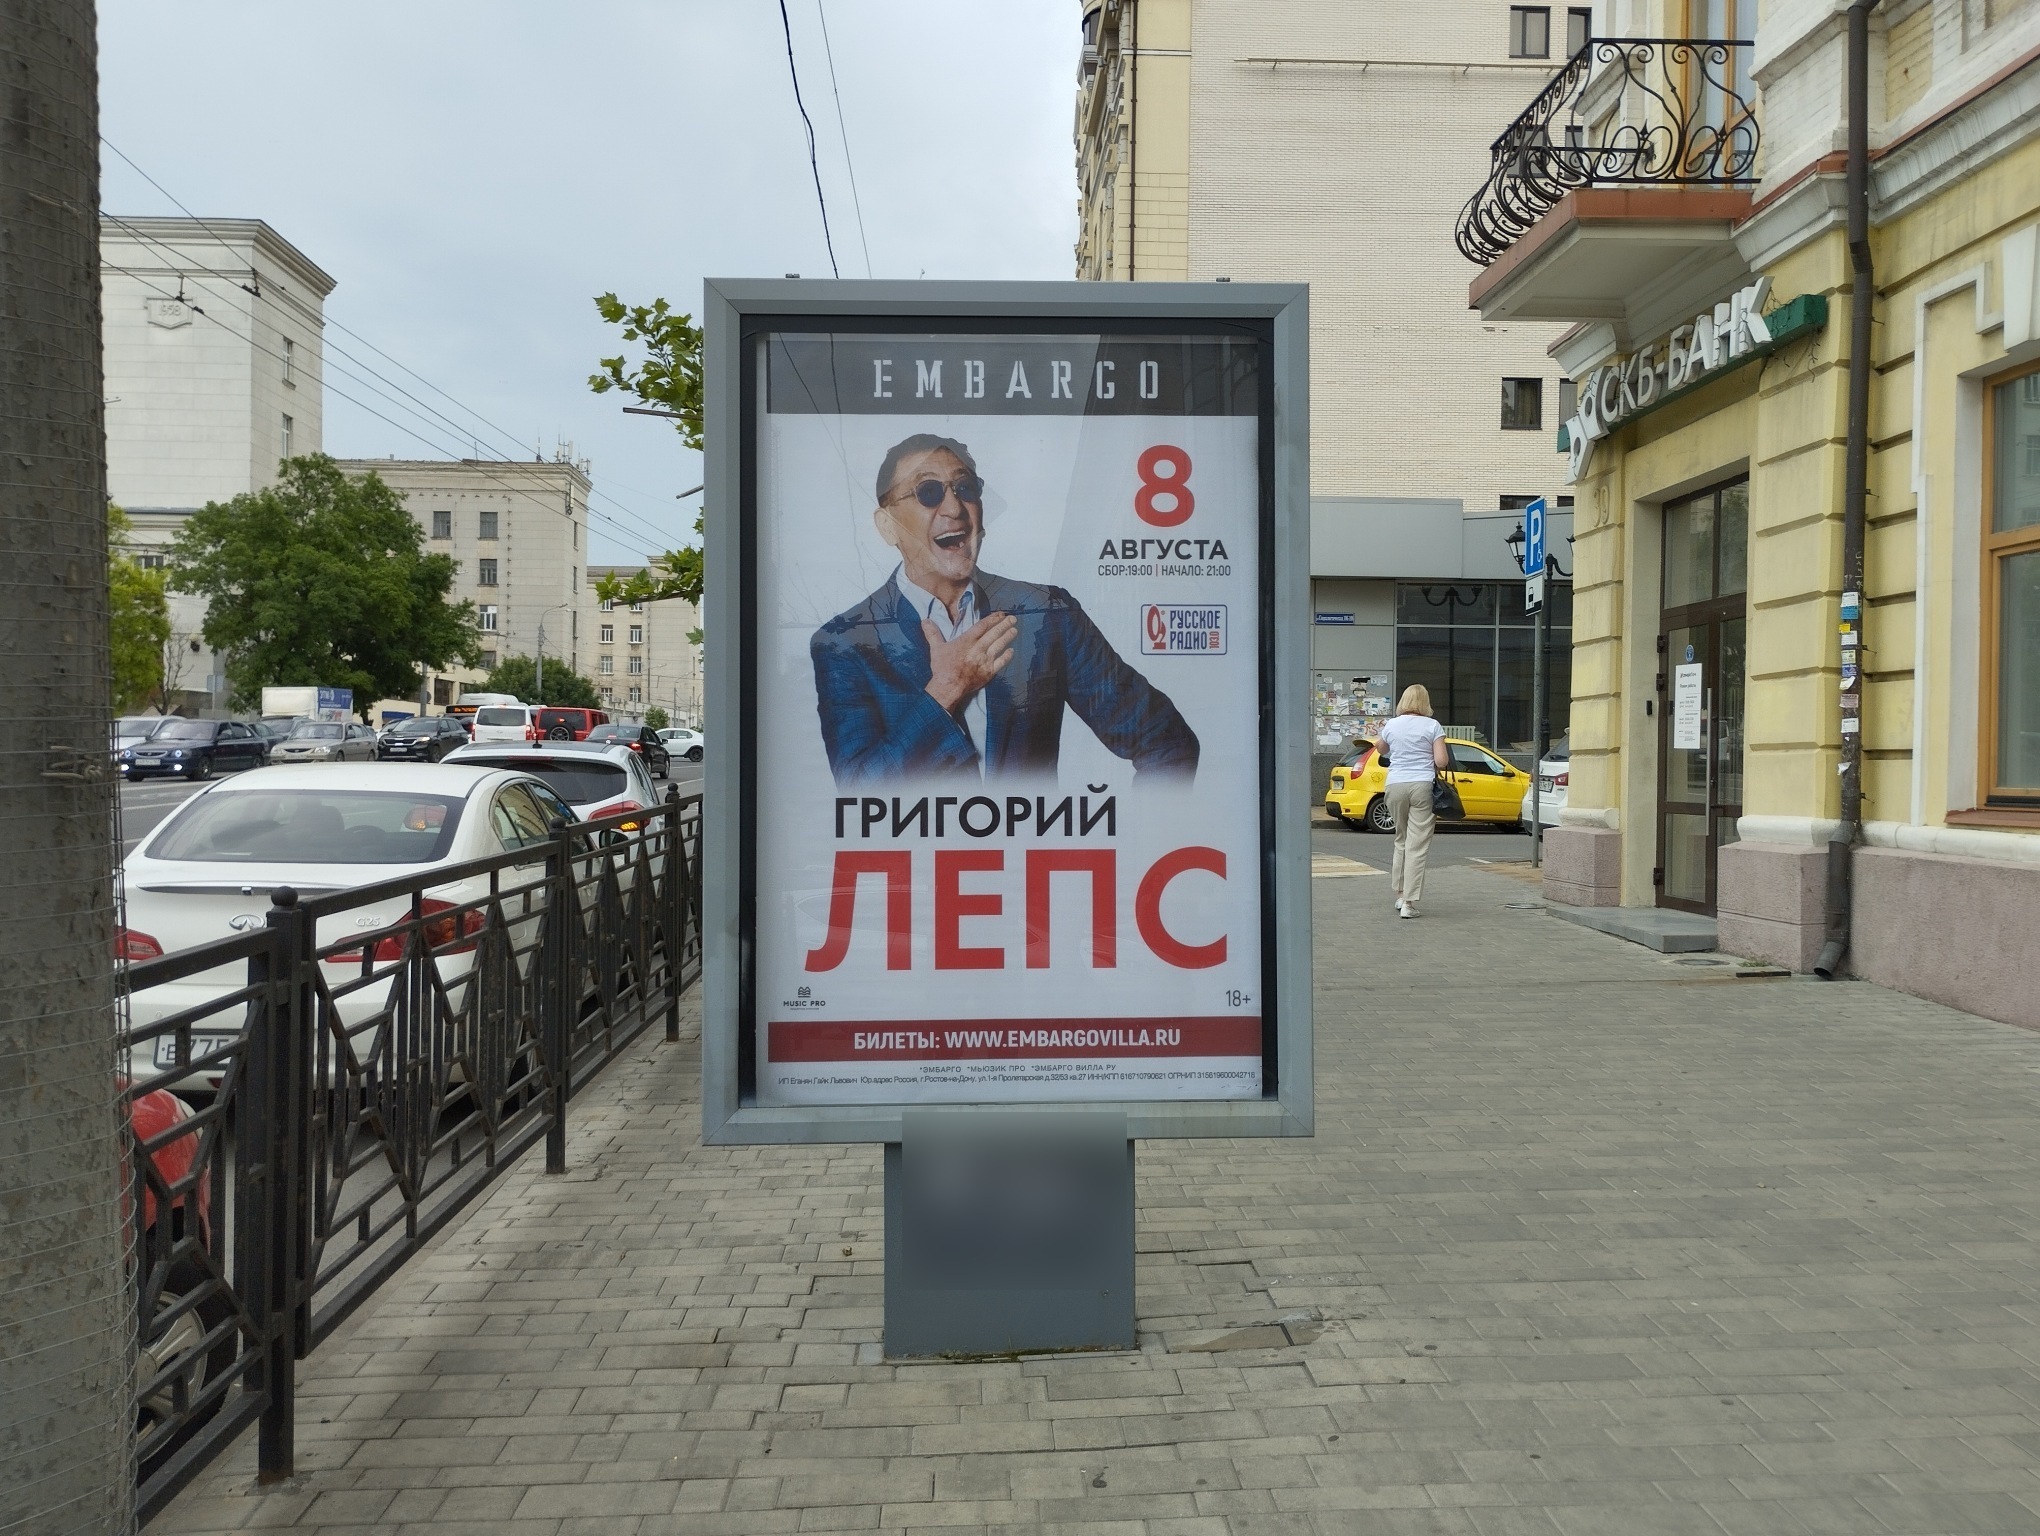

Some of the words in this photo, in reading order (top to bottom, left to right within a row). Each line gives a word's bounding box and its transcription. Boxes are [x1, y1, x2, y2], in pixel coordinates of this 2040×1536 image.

[1600, 275, 1775, 422] СКБ-БАНК
[873, 359, 1160, 400] EMBARGO
[1133, 444, 1195, 527] 8
[1098, 539, 1229, 560] АВГУСТА
[1097, 564, 1153, 577] СБОР:19:00
[1161, 564, 1204, 577] НАЧАЛО:
[1206, 564, 1231, 577] 21:00
[1169, 610, 1221, 629] РУССКОЕ
[1169, 631, 1208, 650] РАДИО
[834, 783, 1117, 839] ГРИГОРИЙ
[804, 846, 1227, 973] ЛЕПС
[355, 916, 381, 927] G25
[1225, 989, 1252, 1008] 18+
[854, 1031, 940, 1050] БИЛЕТЫ:
[944, 1027, 1181, 1049] WWW.EMBARGOVILLA.RU
[1075, 1064, 1104, 1072] ВИЛЛА
